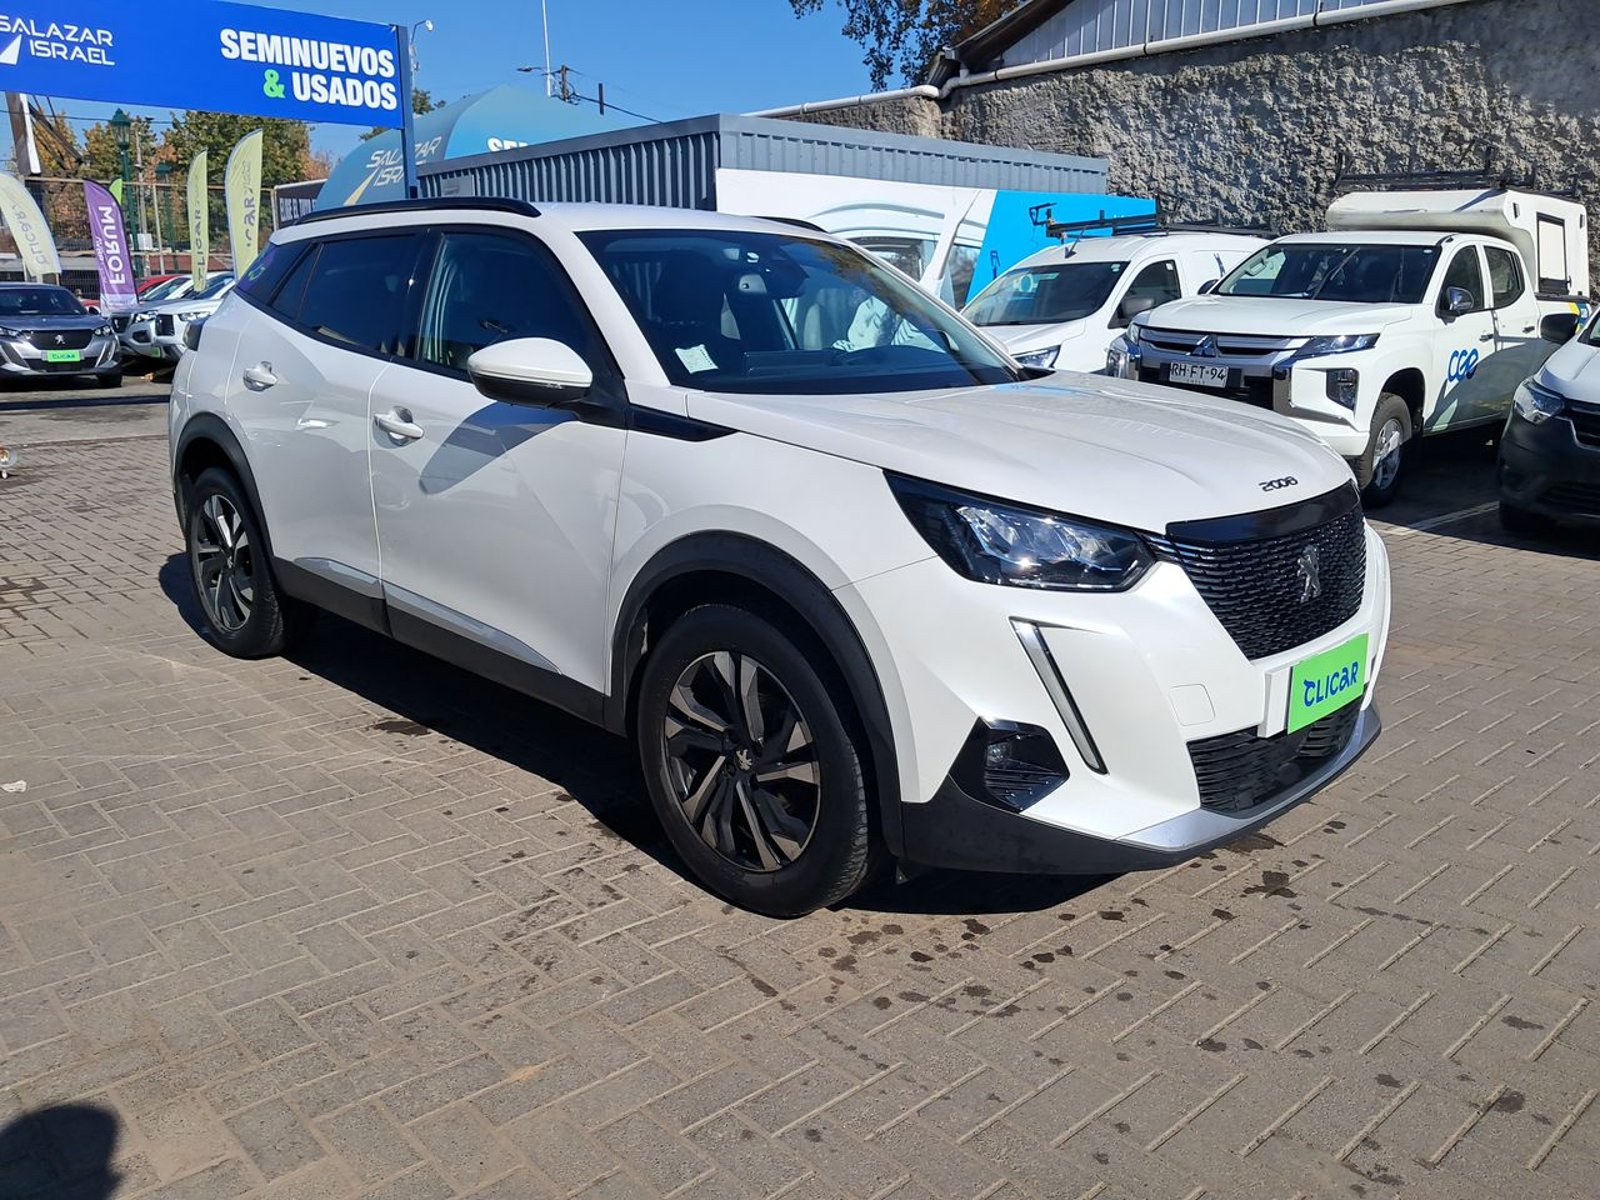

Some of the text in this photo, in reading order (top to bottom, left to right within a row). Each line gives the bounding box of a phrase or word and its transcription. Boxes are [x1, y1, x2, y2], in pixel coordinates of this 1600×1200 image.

[0, 15, 114, 47] SALAZAR
[29, 39, 116, 66] ISRAEL
[220, 28, 396, 78] SEMINUEVOS
[263, 69, 398, 111] & USADOS
[1258, 476, 1298, 492] 2008
